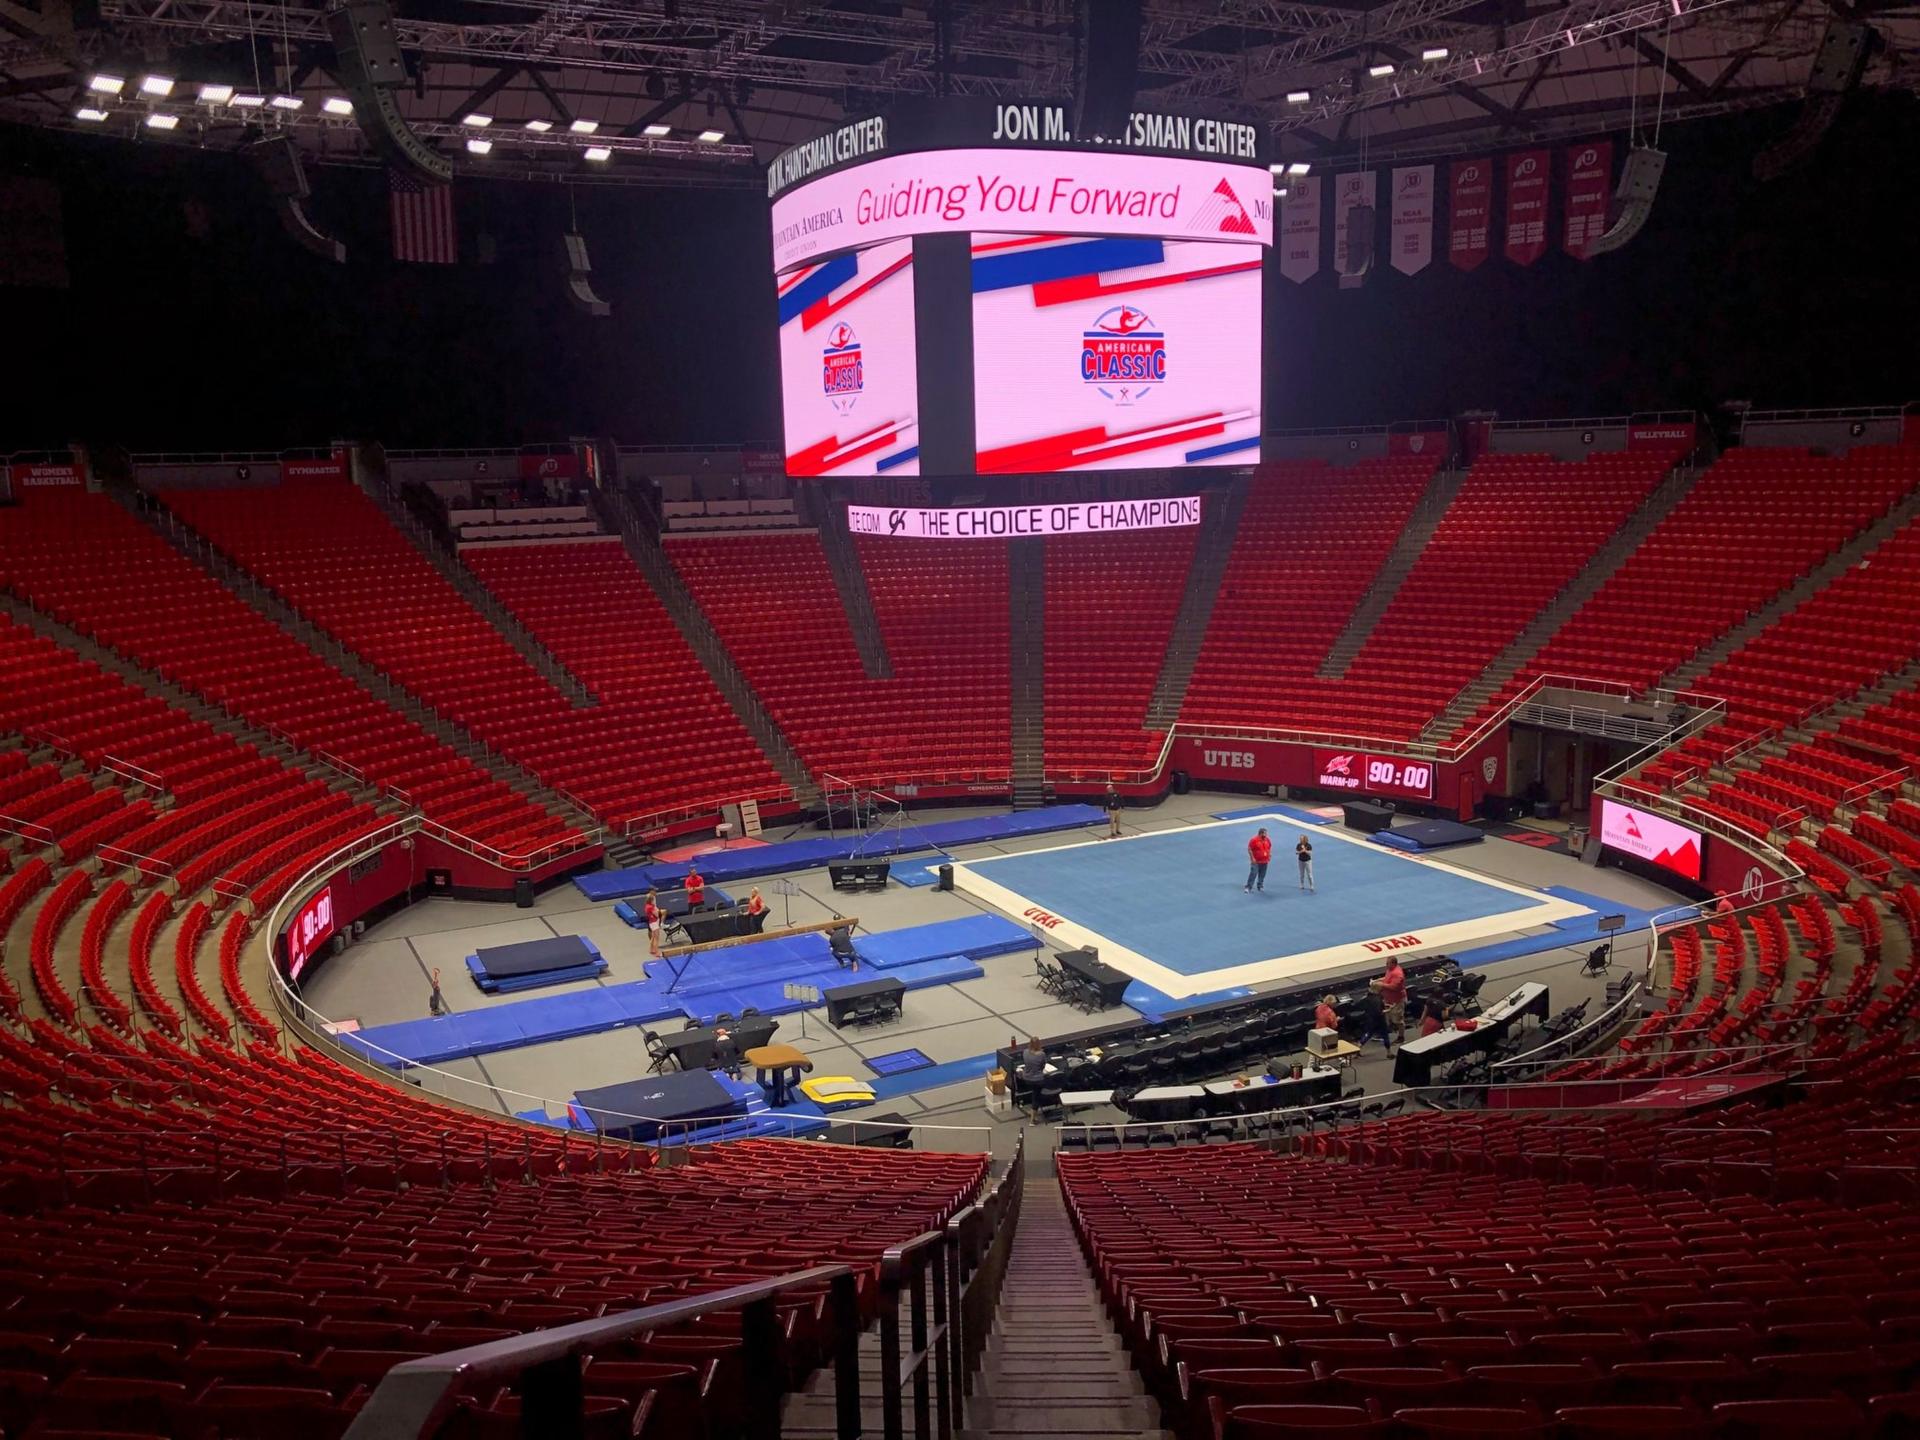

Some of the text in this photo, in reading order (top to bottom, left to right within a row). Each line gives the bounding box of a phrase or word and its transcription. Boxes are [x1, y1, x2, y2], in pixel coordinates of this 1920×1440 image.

[992, 104, 1038, 141] JON
[1044, 107, 1070, 142] M.
[1194, 118, 1256, 158] CENTER
[785, 132, 834, 186] HUNTSMAN
[835, 115, 885, 162] CENTER
[856, 175, 1181, 225] Guiding You Forward
[800, 207, 844, 236] AMERICA
[1097, 343, 1152, 353] AMERICAN
[823, 360, 864, 394] CLASSIC
[1081, 349, 1167, 381] CLASSIC
[919, 511, 950, 536] THE
[956, 508, 1043, 536] CHOICE
[1051, 506, 1080, 532] OF
[1087, 499, 1199, 529] CHAMPIONS
[1204, 750, 1255, 768] UTES
[1320, 774, 1360, 788] WARM-UP
[1368, 761, 1429, 789] 90:00
[303, 895, 330, 945] 90:00
[1023, 907, 1064, 929] UTAH
[1361, 935, 1422, 953] UTAH
